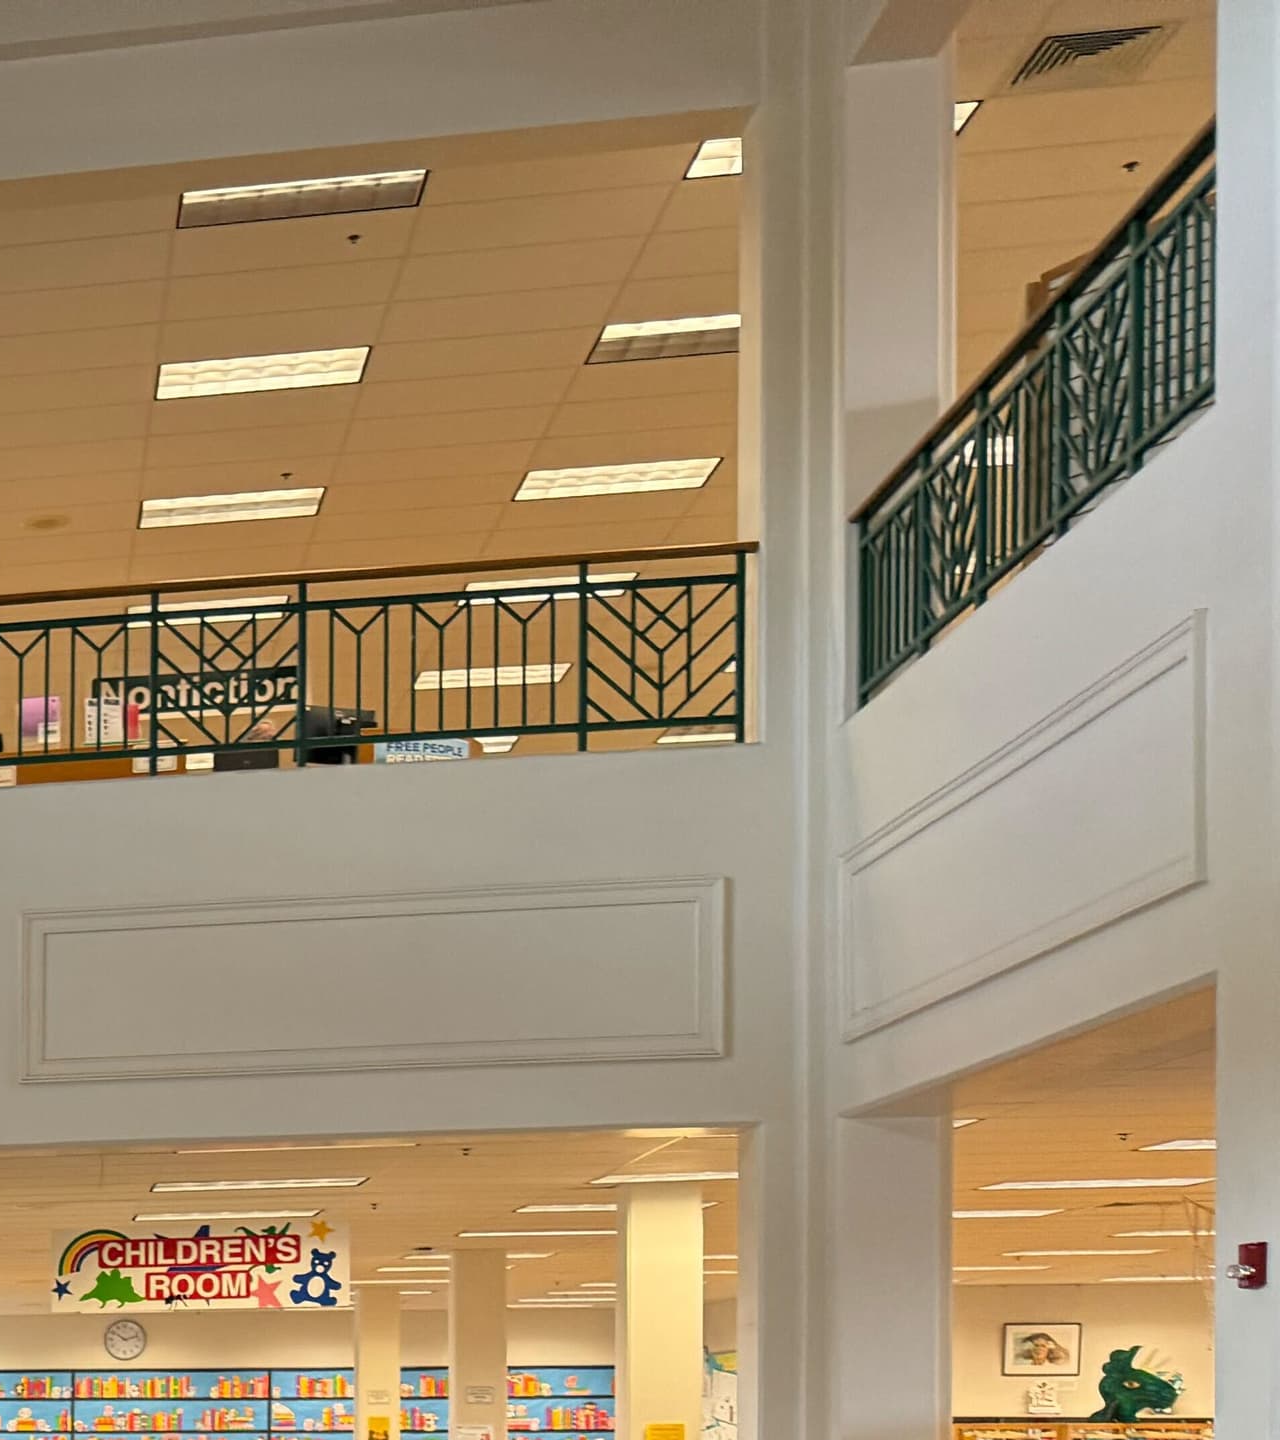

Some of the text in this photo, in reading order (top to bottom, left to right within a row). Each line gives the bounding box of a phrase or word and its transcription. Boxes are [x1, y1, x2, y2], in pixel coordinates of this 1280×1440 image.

[386, 741, 421, 753] FREE
[100, 1236, 299, 1267] CHILDREN'S
[148, 1272, 248, 1299] ROOM
